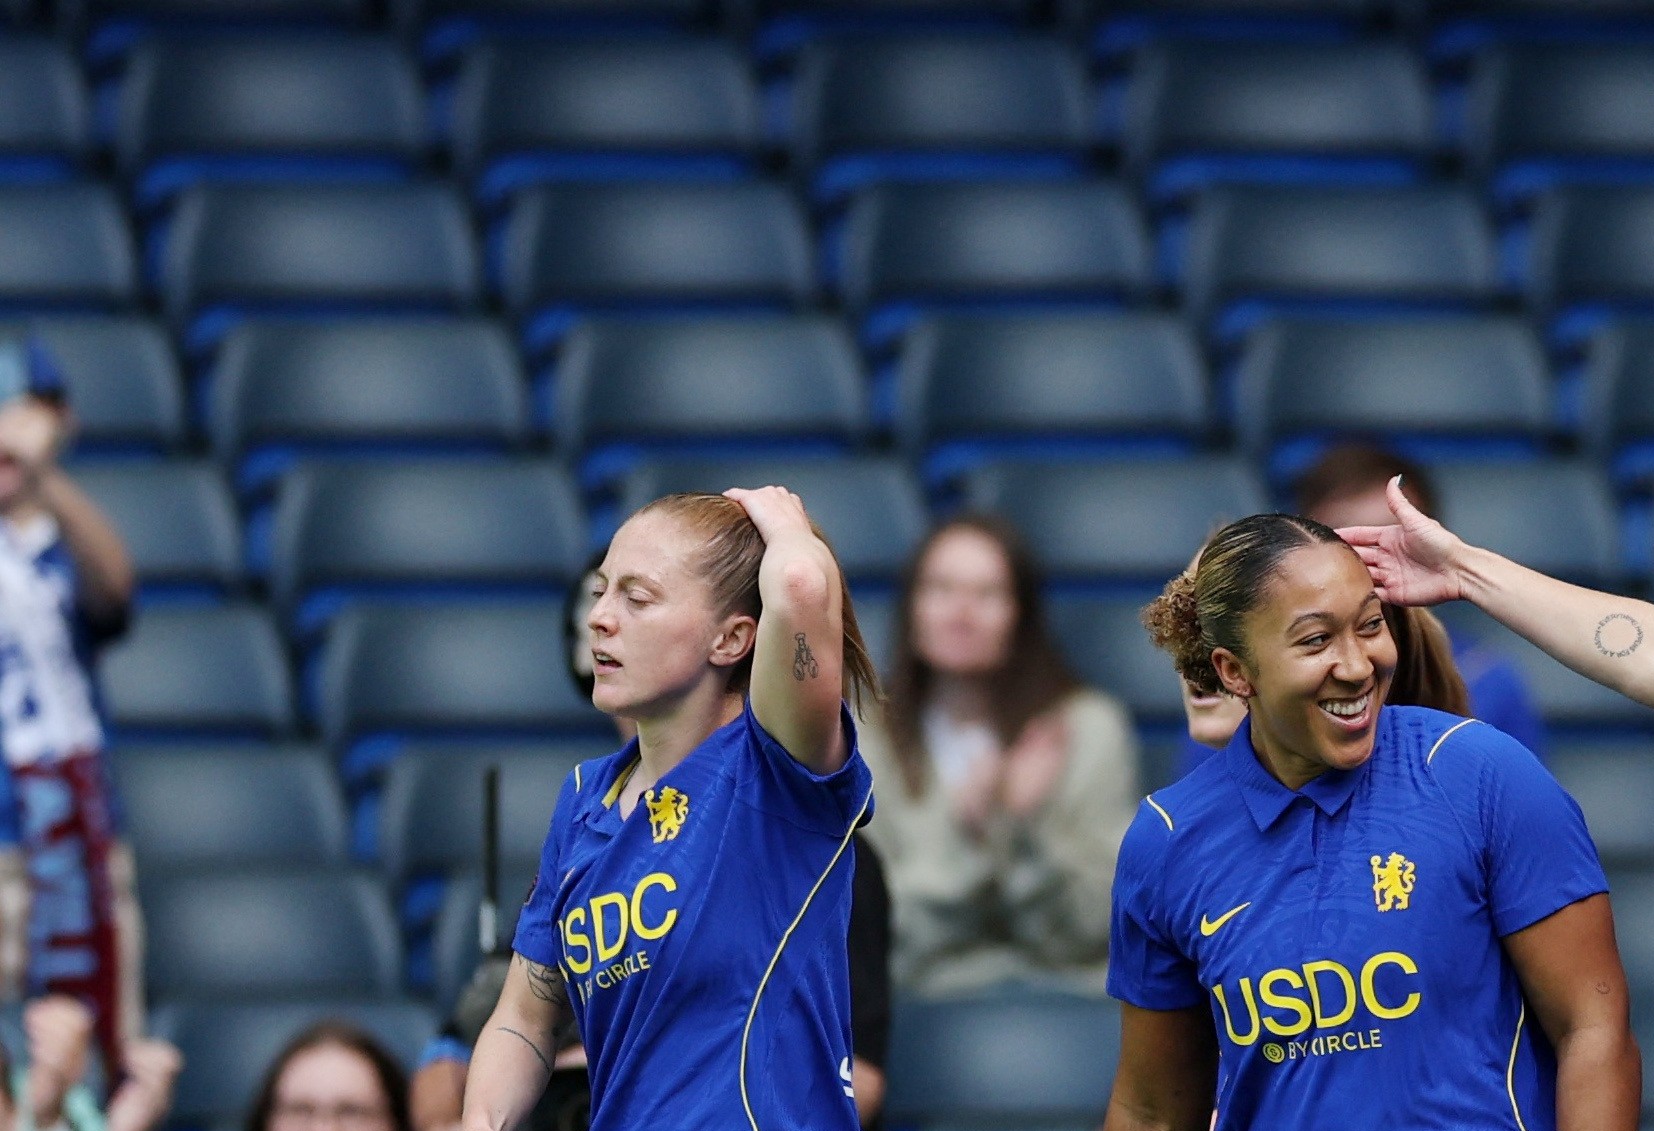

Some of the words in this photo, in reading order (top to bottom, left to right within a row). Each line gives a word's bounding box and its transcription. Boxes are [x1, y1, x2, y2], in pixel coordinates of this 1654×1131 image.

[558, 872, 678, 974] SDC
[1211, 951, 1421, 1046] USDC
[1288, 1040, 1308, 1060] BY
[1311, 1028, 1383, 1056] CIRCLE
